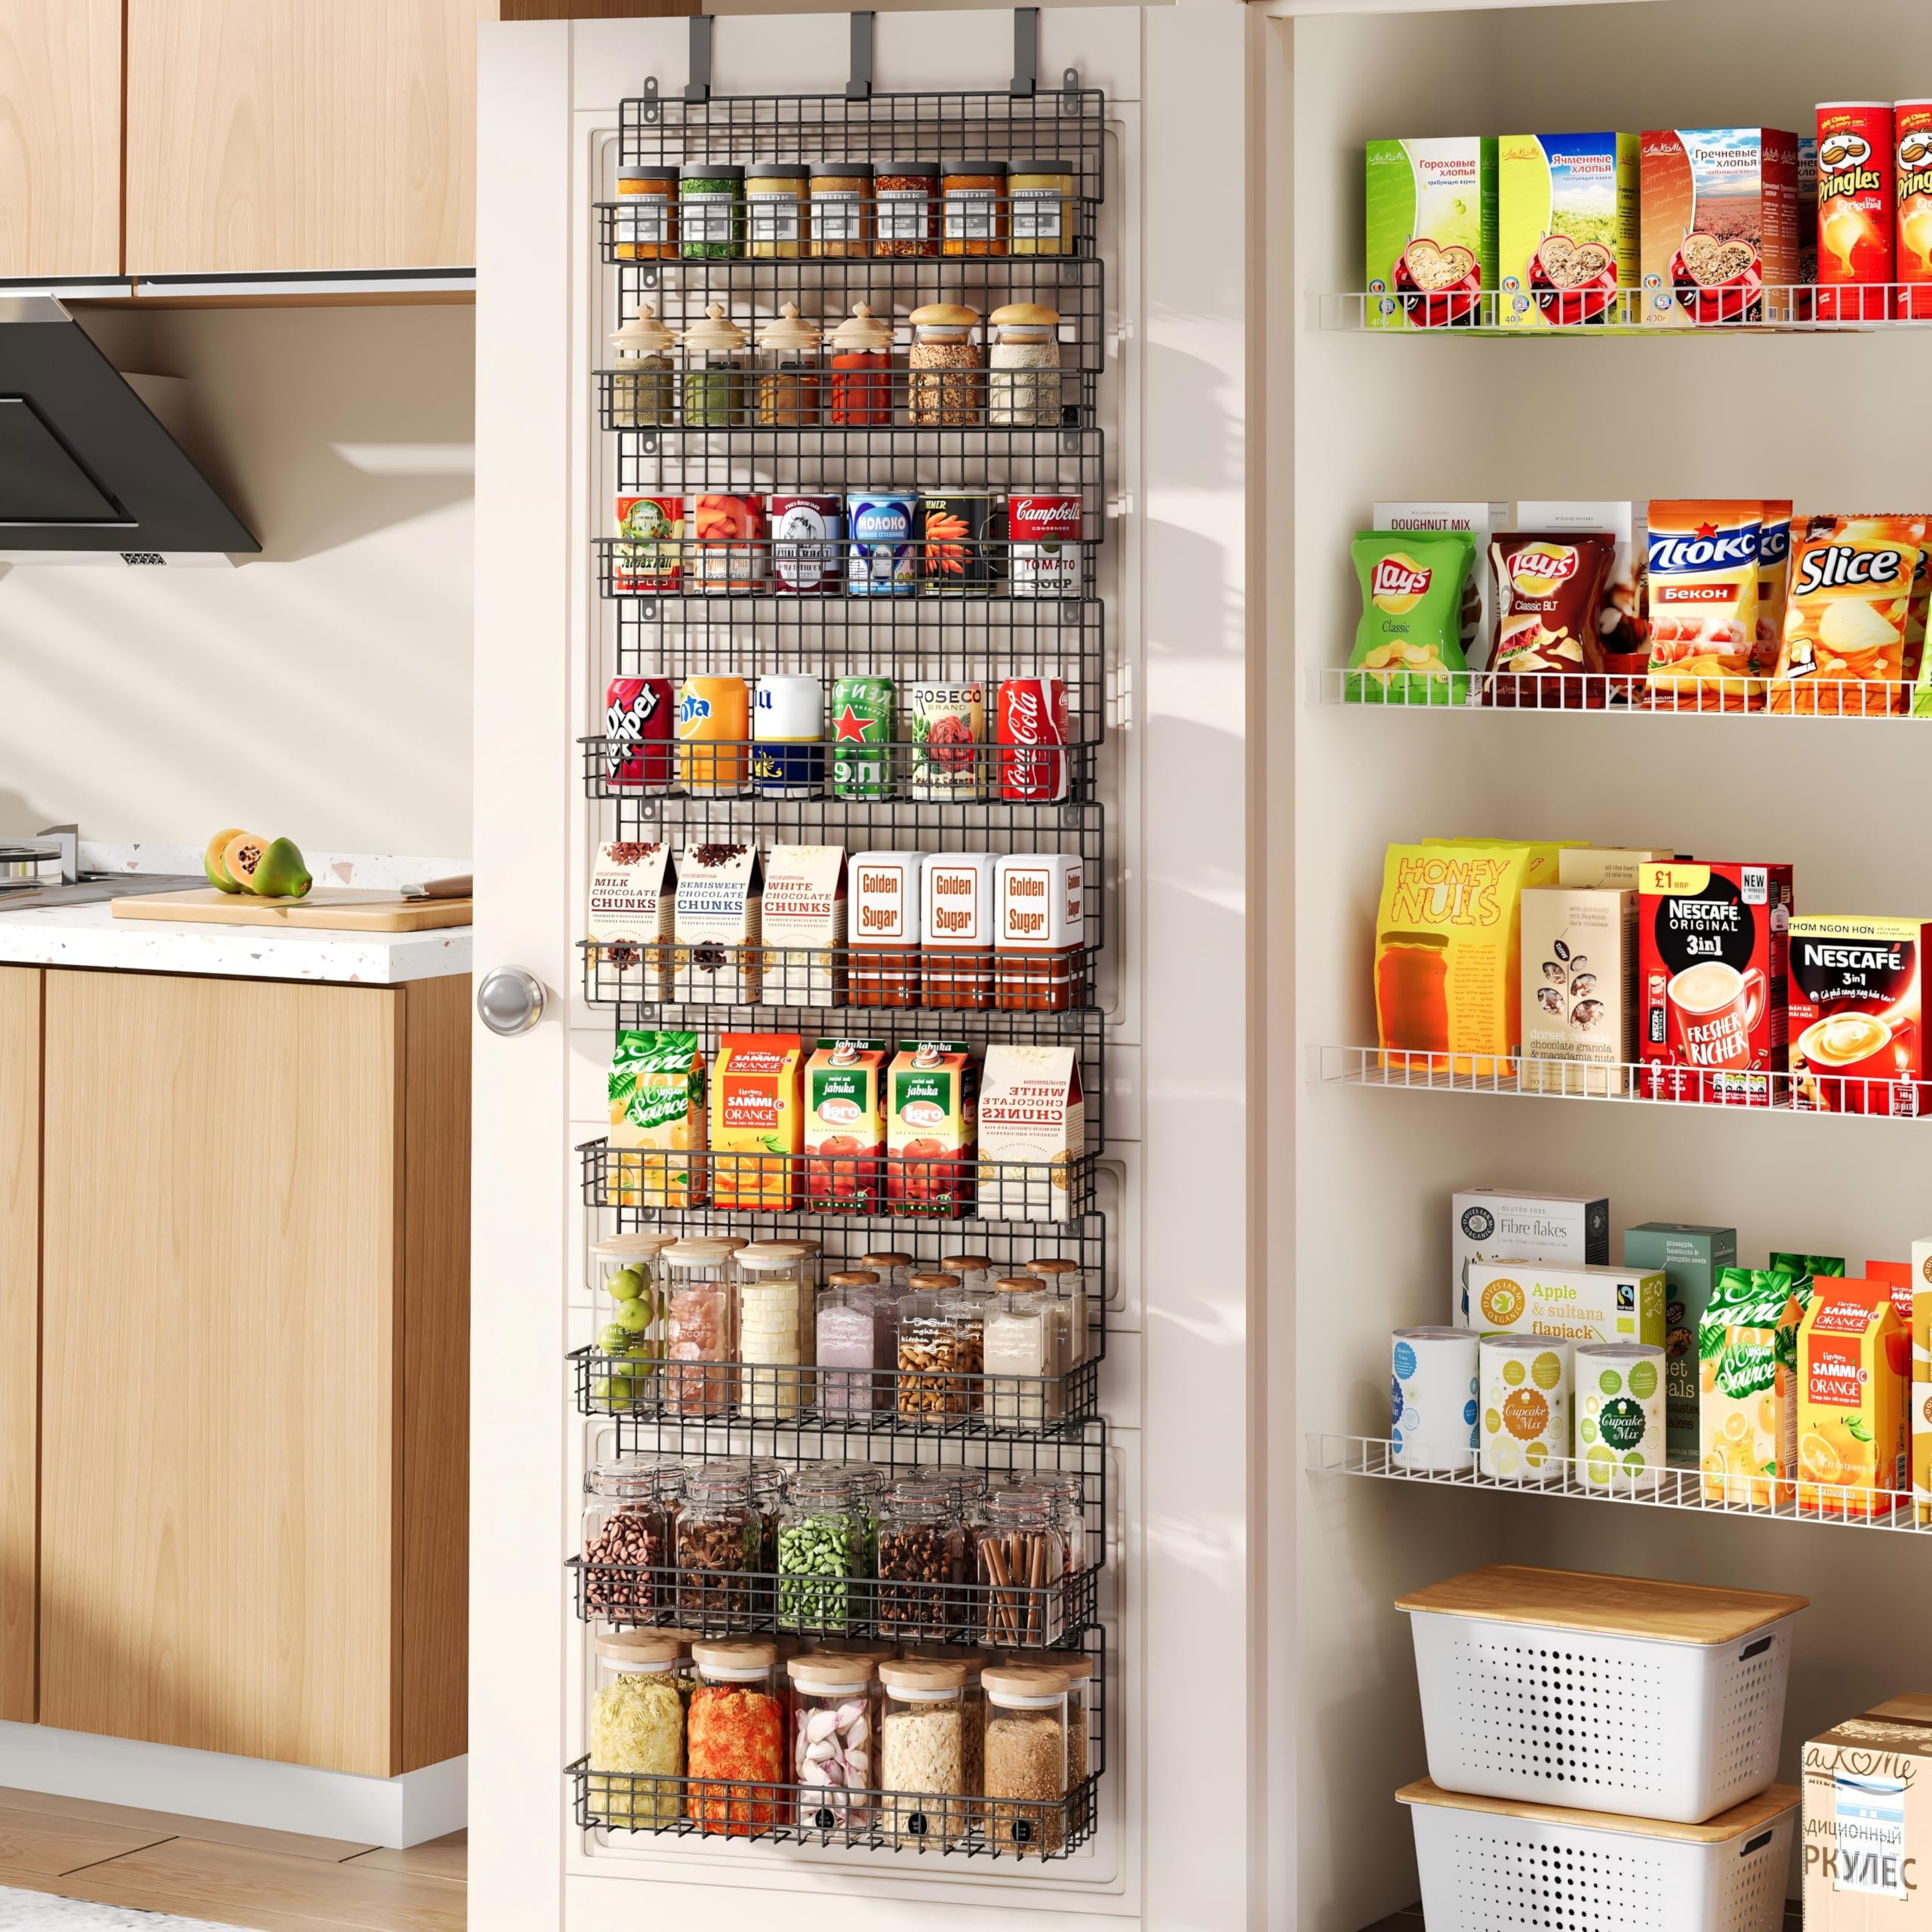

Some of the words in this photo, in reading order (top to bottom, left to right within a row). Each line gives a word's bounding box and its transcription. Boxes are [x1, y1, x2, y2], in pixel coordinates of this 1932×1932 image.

[1553, 155, 1612, 165] Ячменные
[1696, 149, 1757, 161] Гречневые
[1420, 160, 1475, 171] Гороховые
[1818, 166, 1880, 211] Pringles
[1837, 200, 1881, 212] Original
[858, 516, 906, 531] МОЛОКО
[1391, 518, 1448, 530] DOUGHNUT
[1451, 518, 1471, 531] MIX
[1649, 534, 1756, 568] Люкс
[1025, 559, 1075, 571] TOMATO
[1795, 547, 1900, 595] Slice
[1030, 578, 1072, 589] SOUP
[1665, 588, 1727, 599] Бекон
[1515, 600, 1541, 611] Classic
[1543, 601, 1558, 611] BLT
[1382, 620, 1410, 633] Classic
[1398, 857, 1511, 887] HONEY
[594, 878, 629, 887] MILK
[680, 881, 746, 890] SEMISWEET
[863, 874, 897, 894] Golden
[937, 875, 971, 895] Golden
[1655, 871, 1672, 888] £1
[1744, 875, 1764, 888] NEW
[768, 882, 813, 891] WHITE
[1010, 877, 1044, 897] Golden
[678, 891, 744, 899] CHOCOLATE
[591, 898, 656, 909] CHUNKS
[678, 900, 743, 911] CHUNKS
[764, 902, 830, 912] CHUNKS
[1391, 883, 1501, 926] NUTS
[863, 906, 897, 931] Sugar
[937, 907, 971, 932] Sugar
[1009, 909, 1044, 934] Sugar
[1669, 919, 1738, 932] ORIGINAL
[1820, 924, 1849, 933] NGON
[1852, 925, 1875, 934] HƠN
[1555, 942, 1569, 960] new
[1686, 934, 1723, 956] 3in1
[1842, 973, 1866, 986] 3in1
[1687, 1012, 1741, 1043] FRESHER
[1531, 1040, 1574, 1051] chocolate
[1576, 1044, 1612, 1053] granola
[1690, 1031, 1748, 1065] RICHER
[1540, 1051, 1593, 1061] macadamia
[1595, 1054, 1615, 1063] nuts
[823, 1082, 855, 1095] jabuka
[906, 1085, 938, 1098] jabuka
[728, 1097, 773, 1107] SAMMI
[626, 1098, 688, 1124] Source
[725, 1109, 776, 1121] ORANGE
[1463, 1208, 1479, 1225] DOVES
[1501, 1218, 1531, 1235] Fibre
[1534, 1220, 1567, 1238] flakes
[1483, 1281, 1502, 1309] DOVES
[1503, 1281, 1522, 1300] FARM
[1532, 1282, 1577, 1301] Apple
[1487, 1304, 1523, 1324] ORGANIC
[1532, 1302, 1543, 1316] &
[1549, 1304, 1604, 1322] sultana
[1823, 1306, 1868, 1318] SAMMI
[1817, 1315, 1867, 1327] ORANGE
[1718, 1358, 1775, 1393] Source
[1813, 1362, 1856, 1379] SAMMI
[1810, 1378, 1859, 1396] ORANGE
[1505, 1404, 1546, 1420] Cupcake
[1516, 1417, 1542, 1430] Mix
[1601, 1413, 1643, 1429] Cupcake
[1613, 1426, 1638, 1440] Mix
